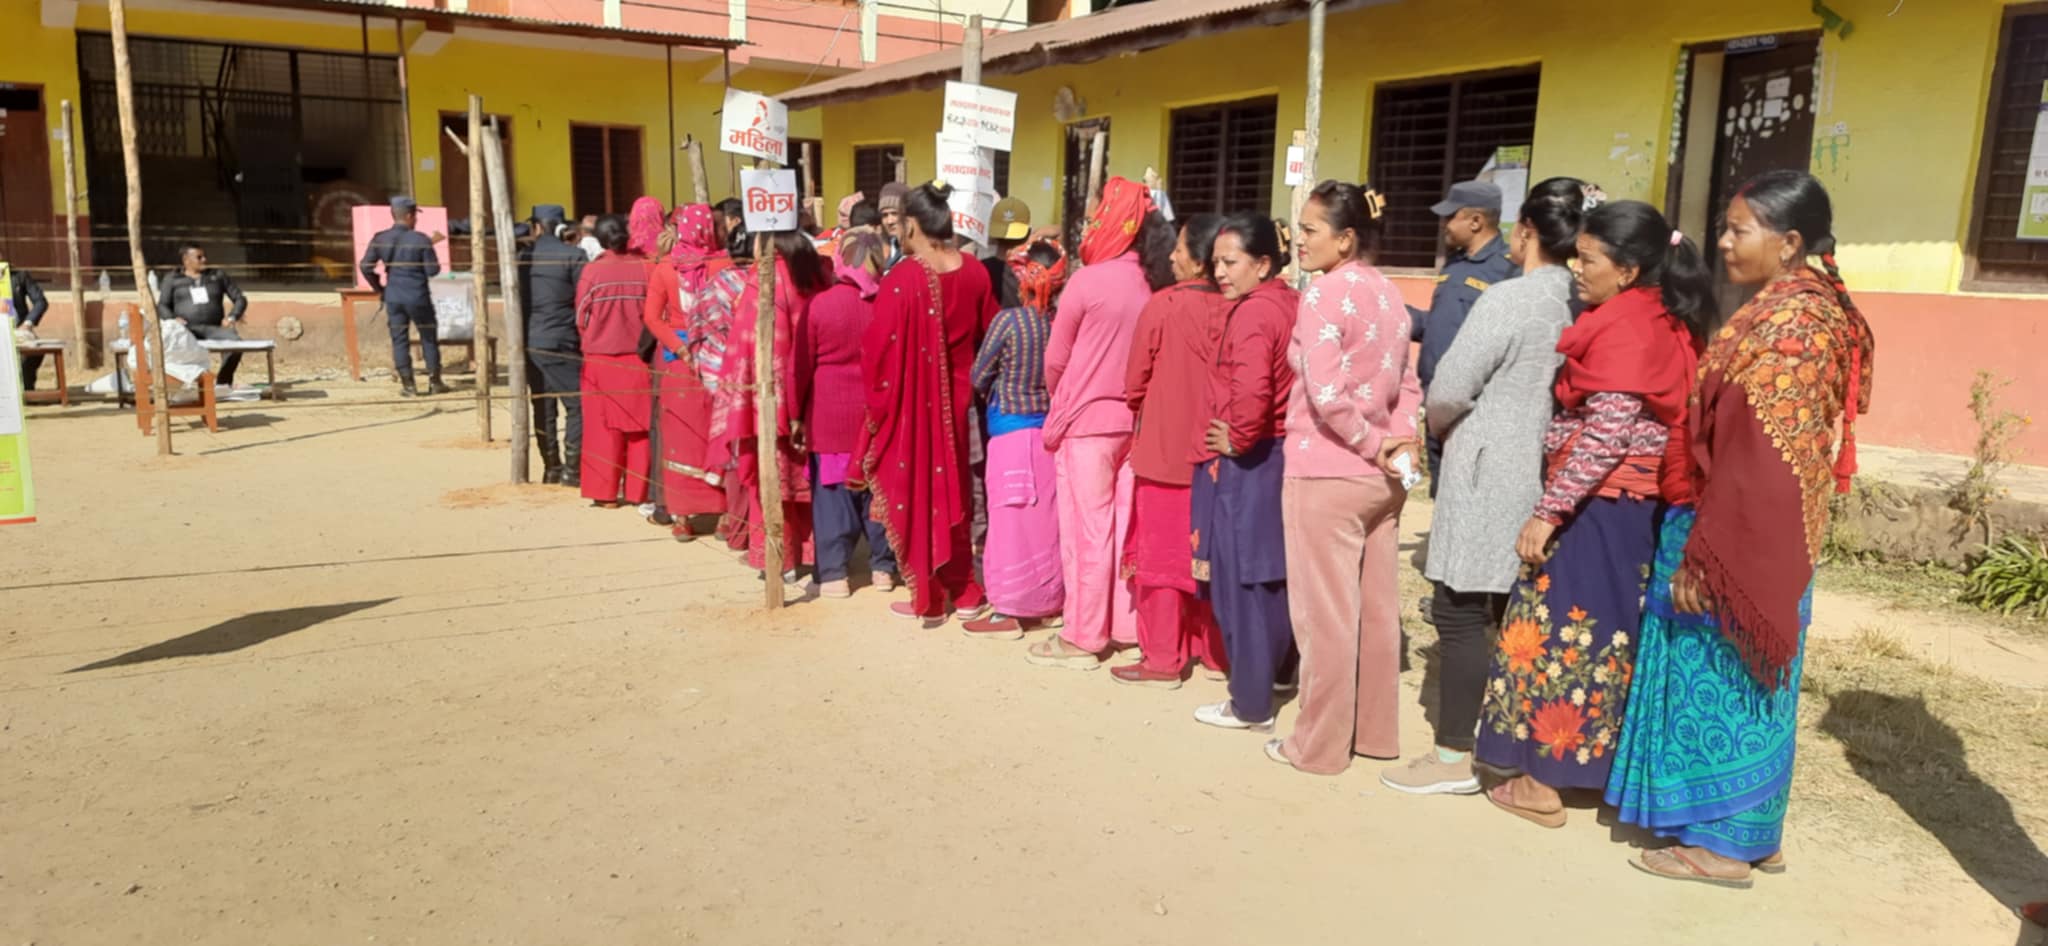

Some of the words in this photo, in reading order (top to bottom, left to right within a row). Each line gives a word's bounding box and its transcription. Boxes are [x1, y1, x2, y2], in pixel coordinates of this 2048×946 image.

[729, 128, 783, 156] महिला
[943, 165, 977, 175] मतदान
[747, 187, 794, 213] भित्र
